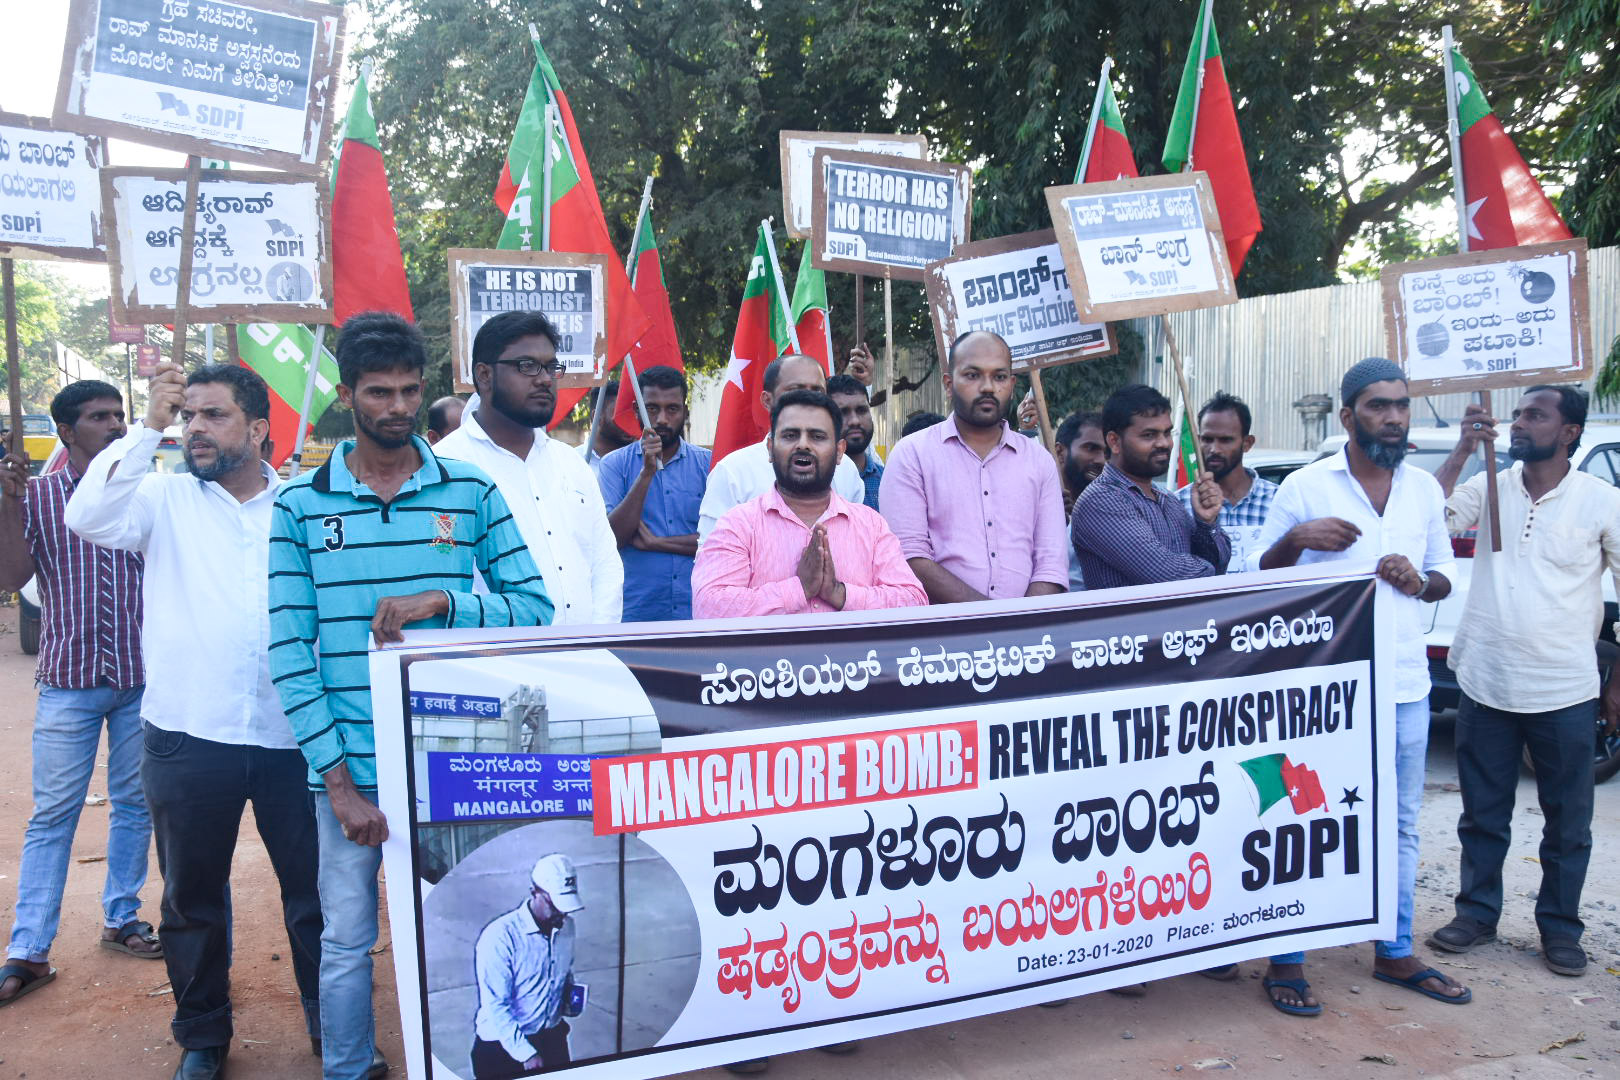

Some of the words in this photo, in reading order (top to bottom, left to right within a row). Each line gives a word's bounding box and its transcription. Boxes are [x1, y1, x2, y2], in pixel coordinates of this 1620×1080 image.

[109, 17, 150, 38] ರಾವ್
[157, 25, 219, 53] ಮಾನಸಿಕ
[110, 44, 174, 73] ಮೊದಲೇ
[182, 59, 225, 83] ನಿಮಗೆ
[19, 140, 76, 168] ಬಾಂಬ್
[0, 169, 76, 202] ಯಲಾಗಲಿ
[835, 169, 907, 204] TERROR
[912, 178, 947, 210] HAS
[834, 201, 860, 231] NO
[864, 205, 947, 242] RELIGION
[485, 270, 512, 291] HE
[515, 271, 536, 291] IS
[540, 272, 578, 292] NOT
[477, 292, 586, 312] TERRORIST
[569, 314, 583, 333] IS
[568, 360, 584, 368] India
[323, 515, 344, 552] 3
[700, 650, 881, 705] ಸೋಶಿಯಲ್
[896, 634, 1055, 693] ಡೆಮಾಕ್ರಟಿಕ್
[1070, 634, 1148, 669] ಪಾರ್ಟಿ
[1162, 618, 1218, 665] ಆಫ್
[1230, 609, 1334, 653] ಇಂಡಿಯಾ
[423, 695, 457, 712] हवाई
[449, 755, 542, 773] ಮಂಗಳೂರು
[557, 757, 592, 773] ಅಂತ
[608, 741, 846, 827] MANGALORE
[855, 729, 973, 798] BOMB:
[989, 712, 1107, 780] REVEAL
[1113, 705, 1170, 764] THE
[1177, 679, 1358, 754] CONSPIRACY
[473, 776, 539, 798] मंगलूर
[552, 779, 592, 793] अन्त
[454, 799, 564, 816] MANGALORE
[713, 792, 1026, 917] ಮಂಗಳೂರು
[1052, 761, 1220, 864] ಬಾಂಬ್
[1222, 899, 1305, 931] ಮಂಗಳೂರು
[717, 899, 950, 1014] ಷಡ್ಯಂತ್ರವನ್ನು
[962, 852, 1212, 952] ಬಯಲಿಗೆಳೆಯಿರಿ
[1018, 952, 1063, 973] Date:
[1067, 934, 1154, 965] 23-01-2020
[1167, 922, 1215, 942] Place:
